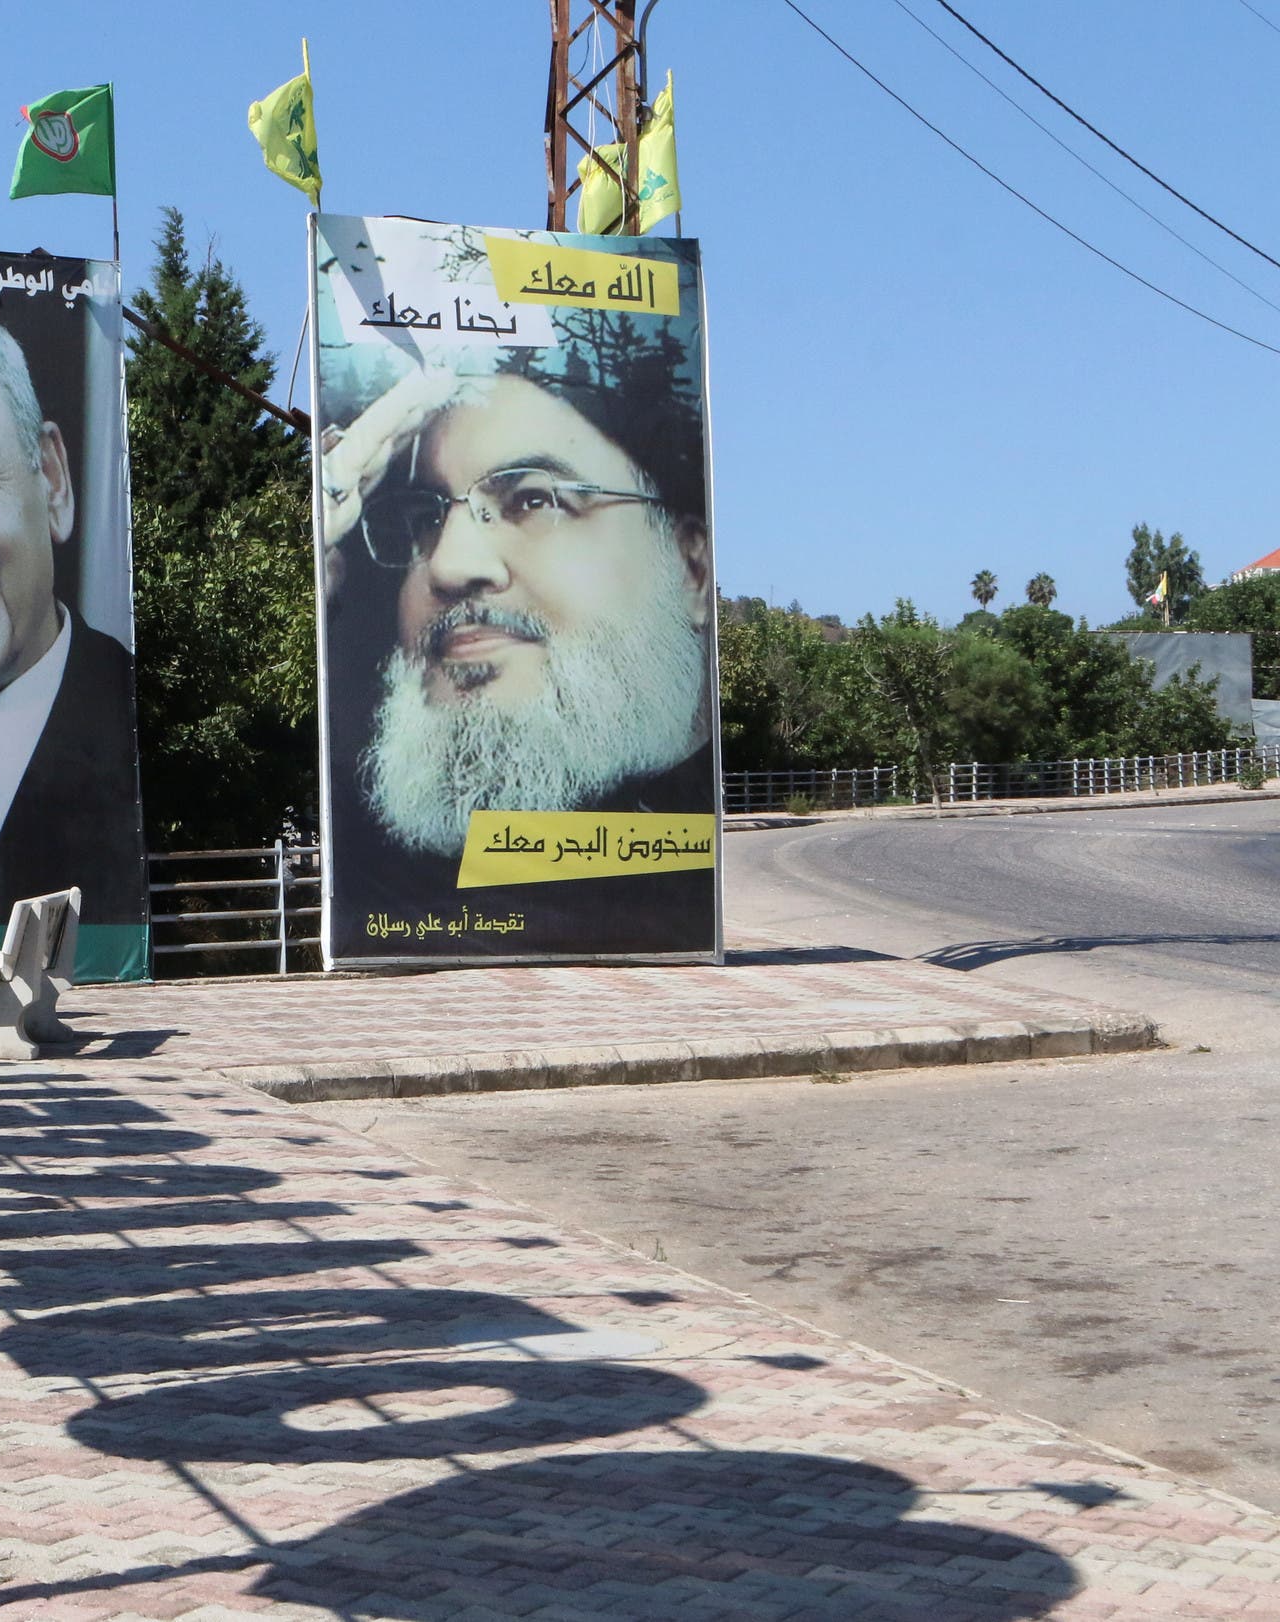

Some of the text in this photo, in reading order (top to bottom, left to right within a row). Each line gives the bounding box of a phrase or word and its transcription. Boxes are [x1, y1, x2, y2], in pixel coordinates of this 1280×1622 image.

[519, 260, 656, 309] الله معك
[359, 291, 518, 338] نحنا معك
[483, 825, 711, 863] سنخوض البحر معك
[366, 905, 525, 940] تقدمة أبو علي رسلان
